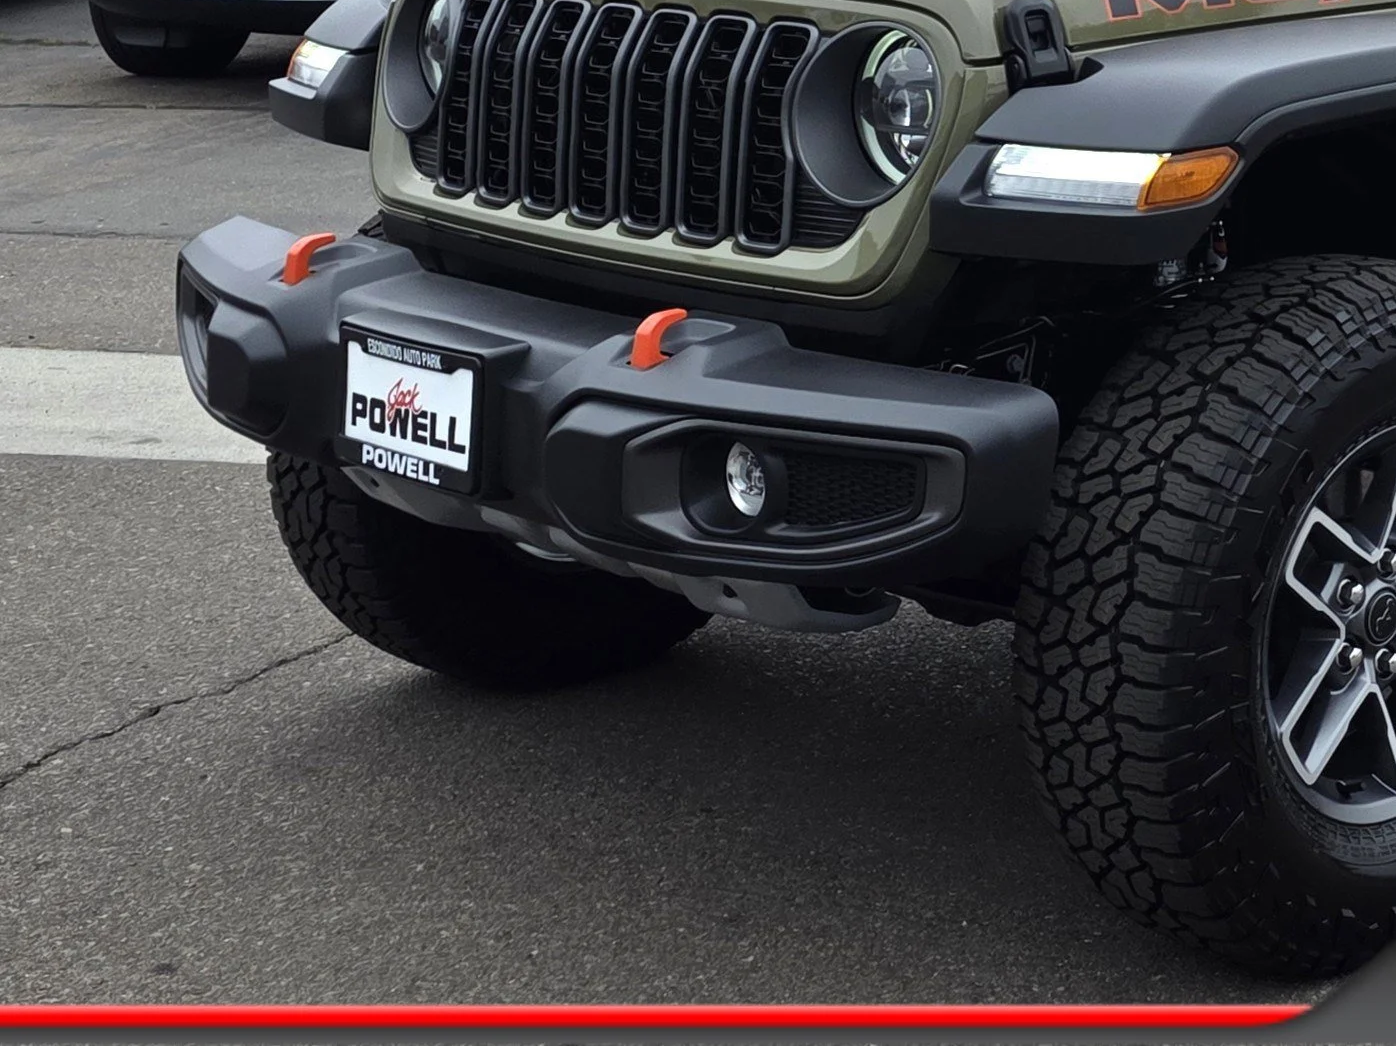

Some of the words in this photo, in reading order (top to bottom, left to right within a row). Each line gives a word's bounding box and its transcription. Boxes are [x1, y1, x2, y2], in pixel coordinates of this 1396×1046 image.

[403, 347, 421, 366] AUTO
[421, 352, 443, 370] PARK
[351, 391, 466, 455] POWELL
[387, 377, 422, 424] Jack
[362, 443, 440, 486] POWELL
